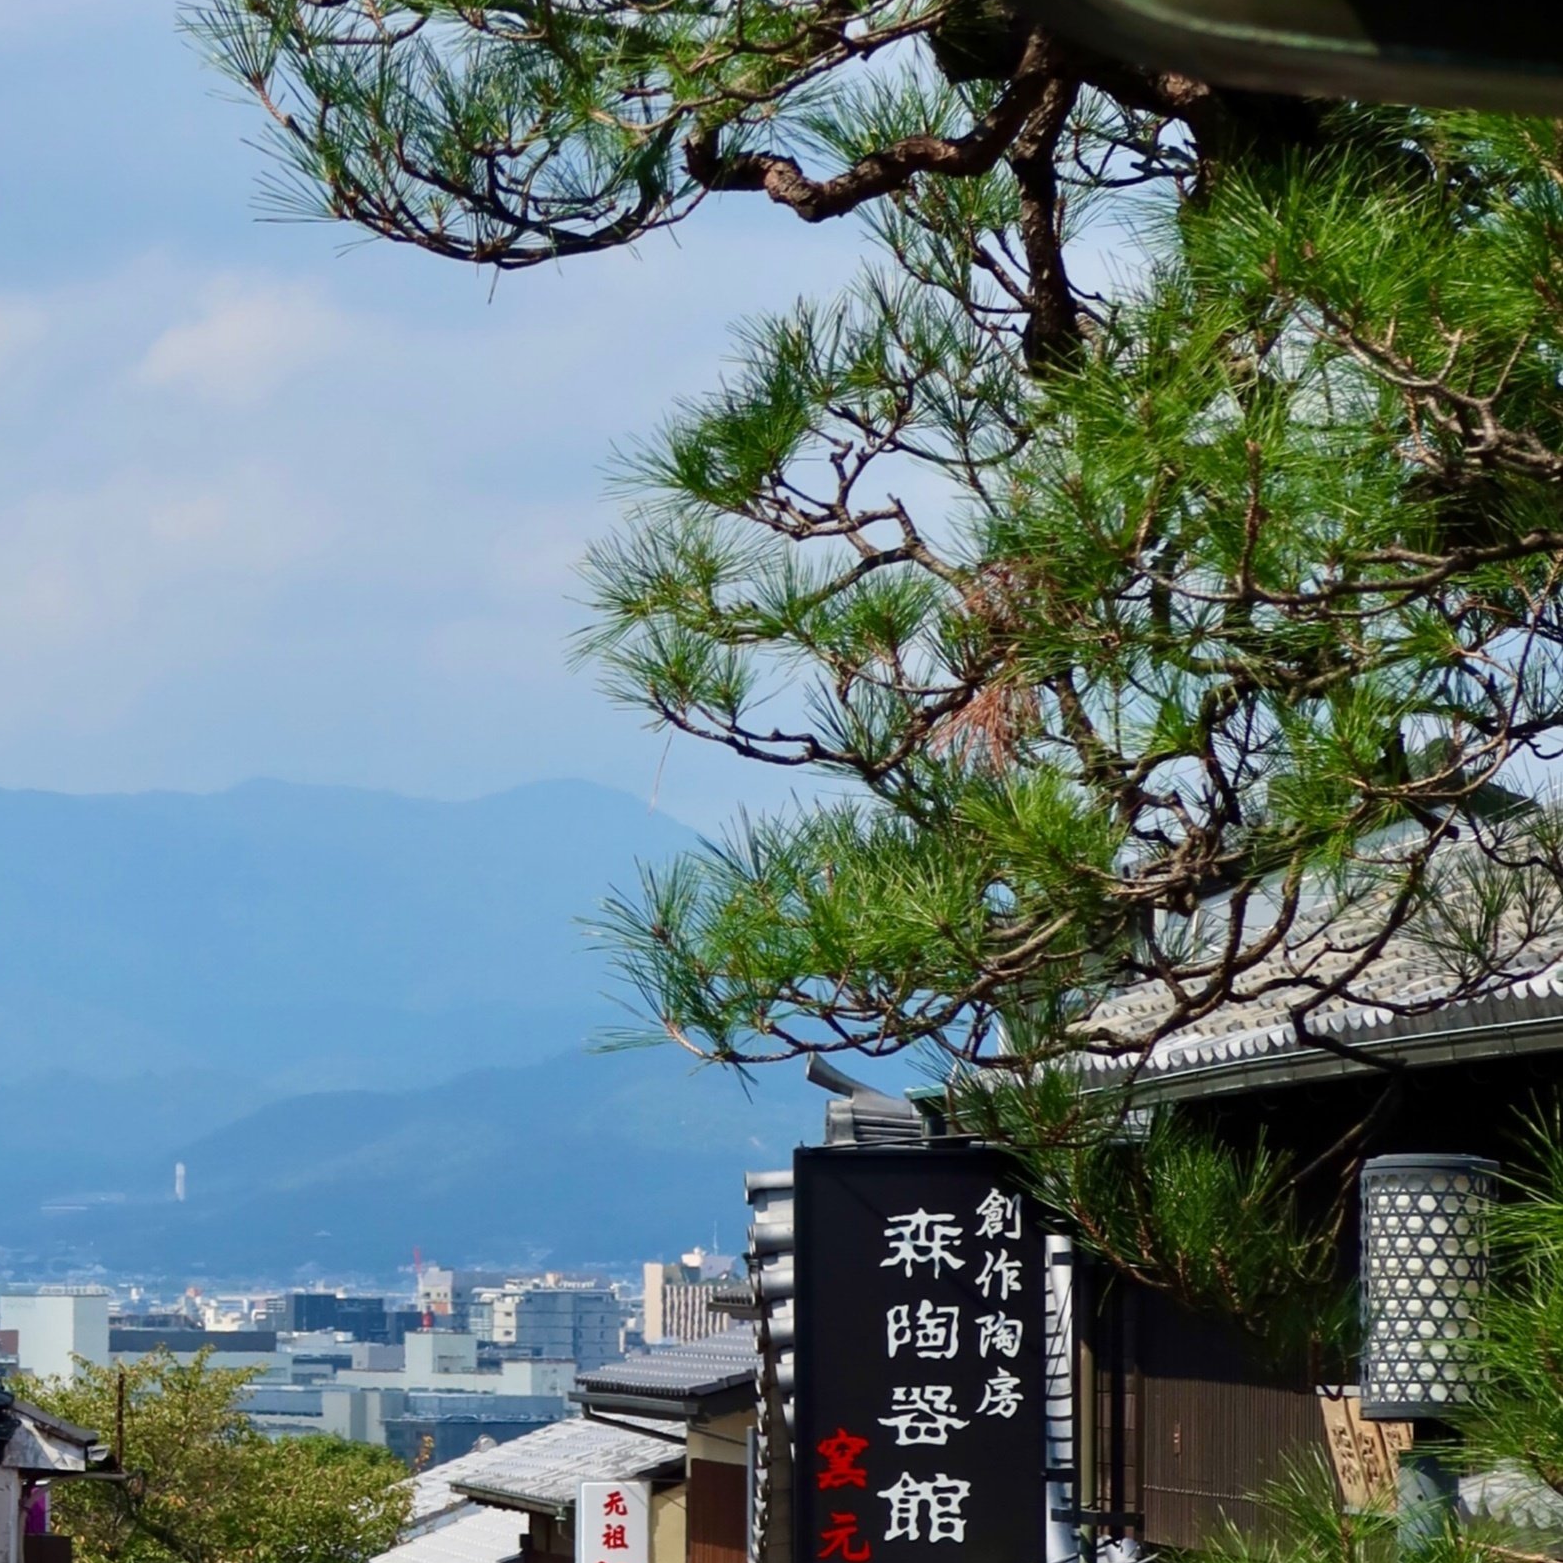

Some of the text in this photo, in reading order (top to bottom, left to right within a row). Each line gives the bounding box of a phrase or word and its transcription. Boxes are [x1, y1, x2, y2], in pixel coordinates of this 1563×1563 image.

[876, 1207, 971, 1544] 森陶器館
[974, 1187, 1025, 1420] 創作陶房
